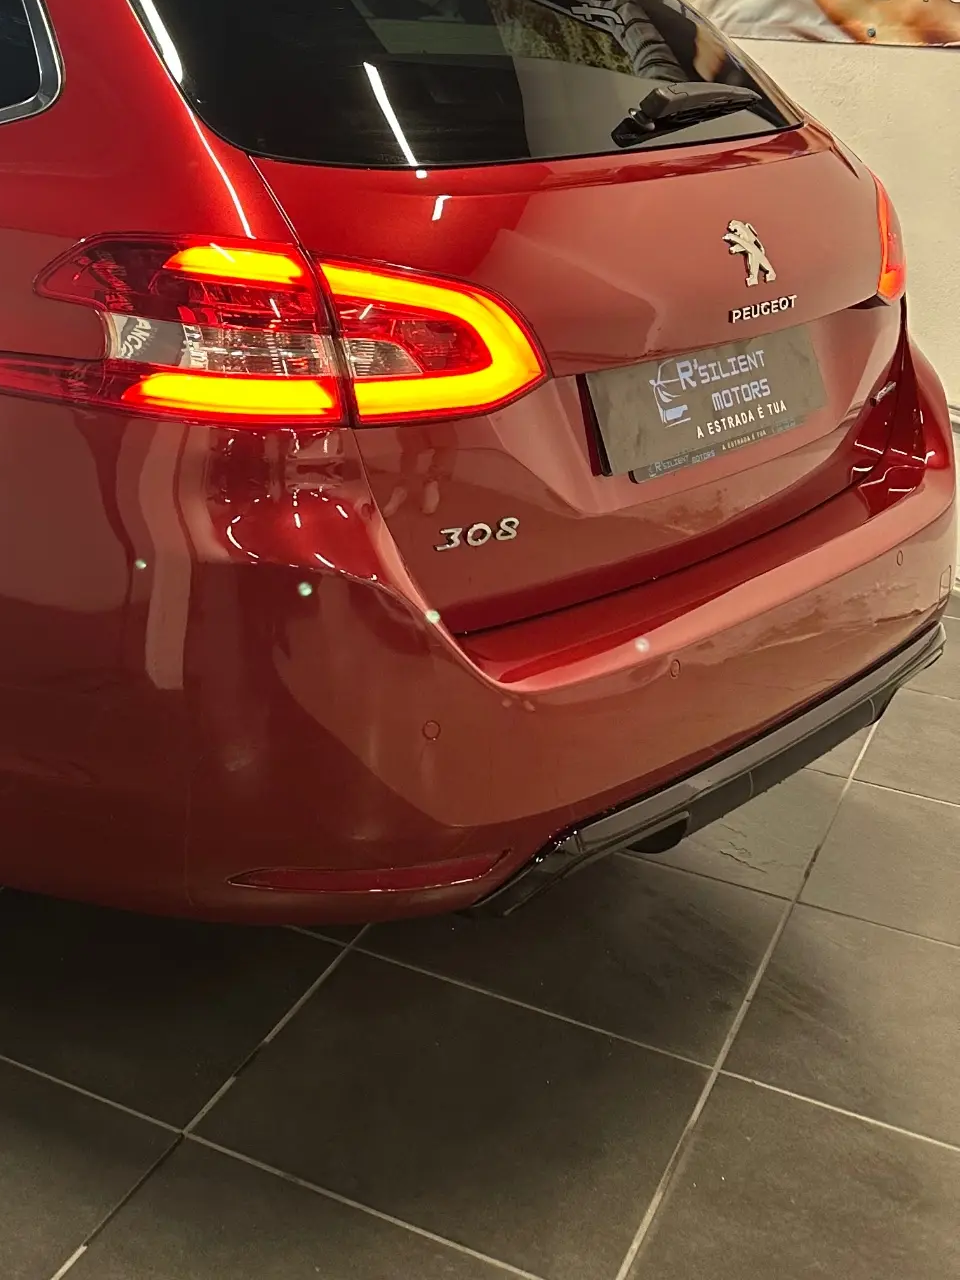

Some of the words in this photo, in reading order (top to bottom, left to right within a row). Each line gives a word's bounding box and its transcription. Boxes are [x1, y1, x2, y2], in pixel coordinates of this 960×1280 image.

[729, 294, 798, 324] PEUGEOT
[675, 349, 765, 391] R'SILIENT
[711, 378, 771, 412] MOTORS
[696, 426, 705, 439] A
[706, 410, 756, 436] ESTRADA
[767, 400, 788, 415] TUA
[434, 517, 520, 551] 308
